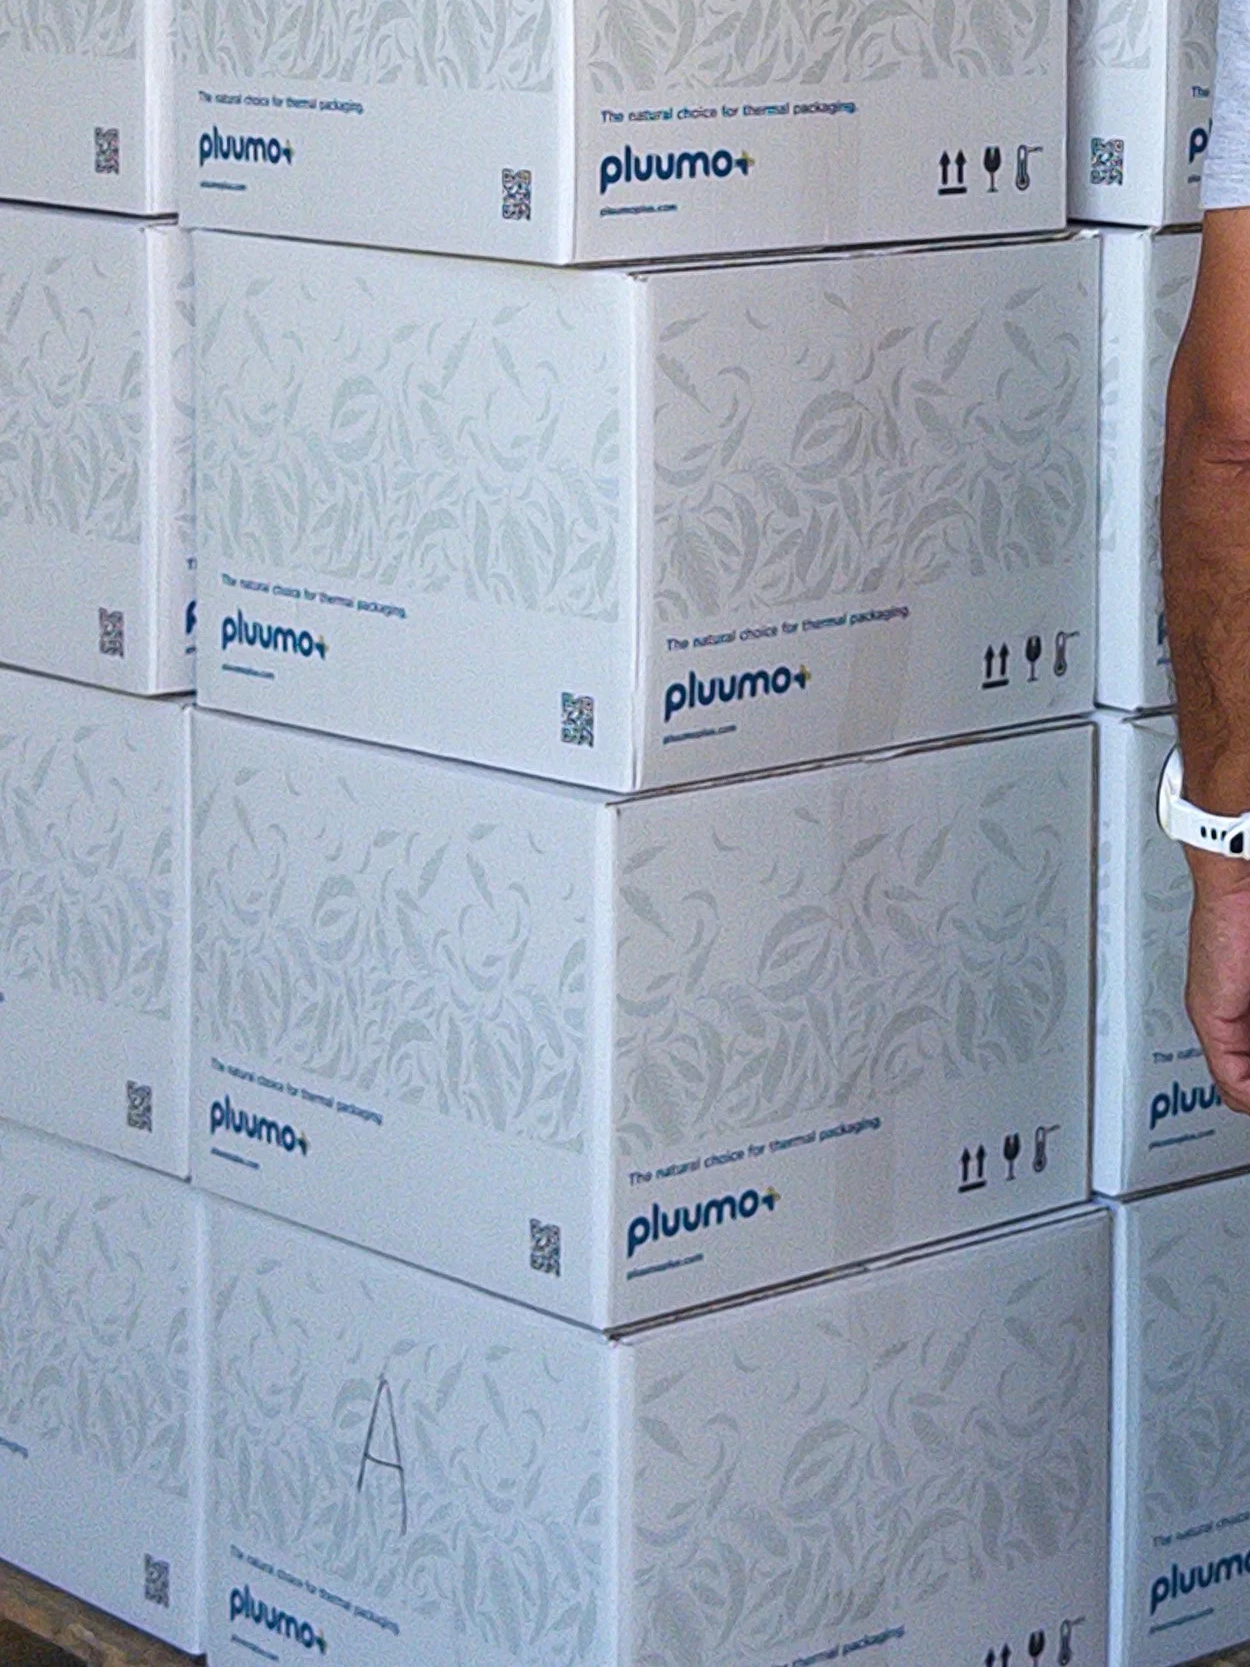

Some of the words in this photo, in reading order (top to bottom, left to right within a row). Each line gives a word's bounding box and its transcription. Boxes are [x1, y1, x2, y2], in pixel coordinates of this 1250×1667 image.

[601, 109, 625, 123] The
[677, 106, 718, 120] choice
[357, 1372, 408, 1536] A
